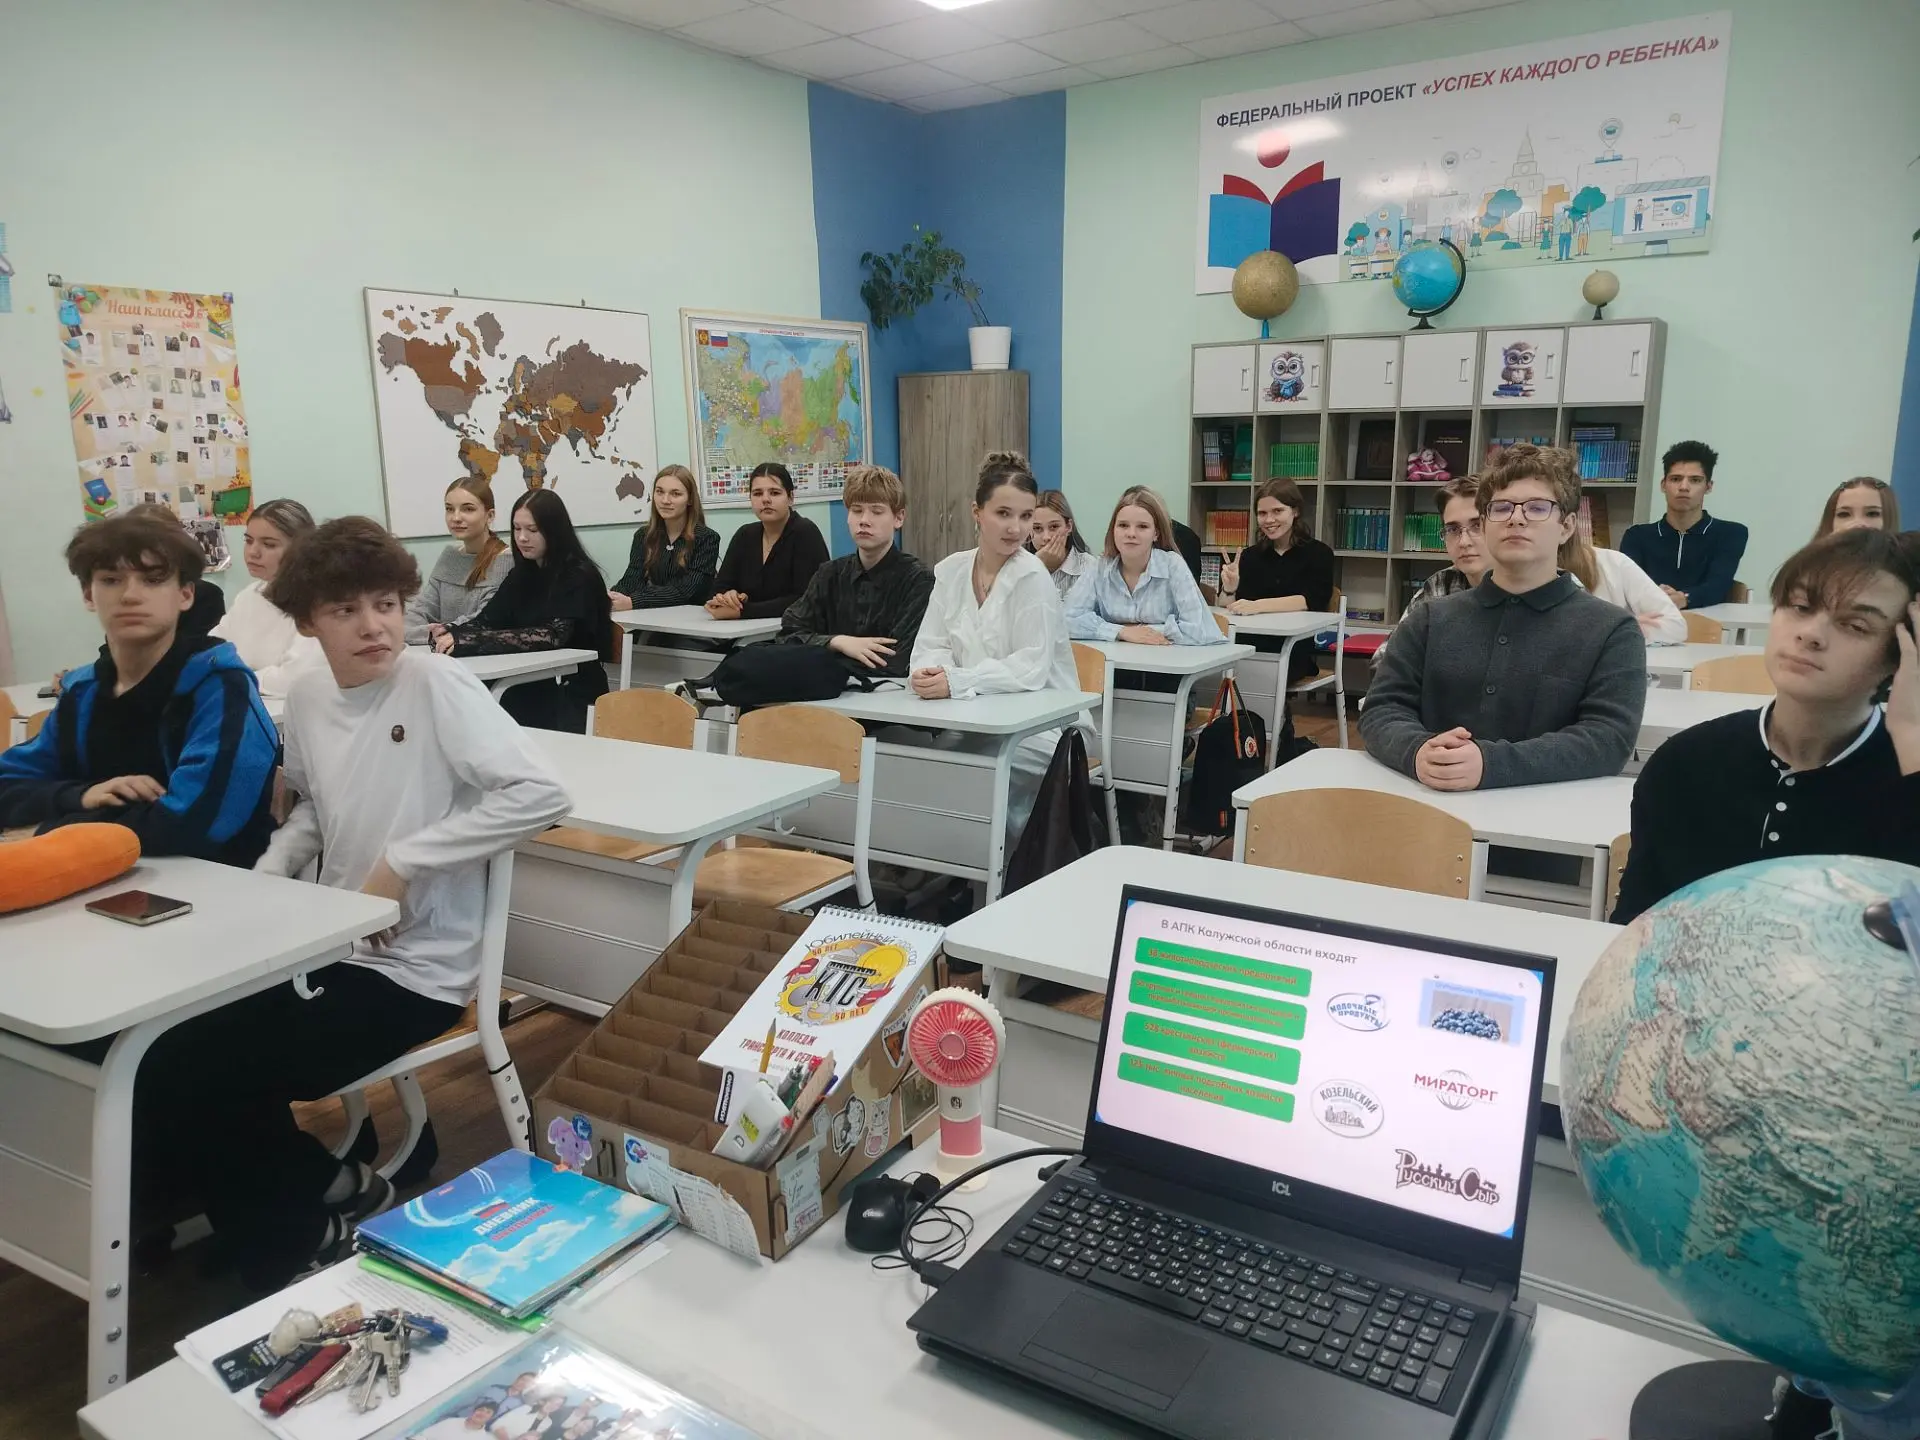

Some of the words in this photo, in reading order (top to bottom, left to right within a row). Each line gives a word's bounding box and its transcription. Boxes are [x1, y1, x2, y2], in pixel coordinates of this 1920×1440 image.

[1216, 92, 1342, 128] ФЕДЕРАЛЬНЫЙ
[1347, 83, 1417, 108] ПРОЕКТ
[1421, 70, 1494, 96] «УСПЕХ
[1499, 53, 1602, 85] КАЖДОГО
[1607, 35, 1720, 67] РЕБЕНКА»
[107, 300, 141, 315] Наш
[144, 304, 184, 319] класс
[805, 929, 896, 951] Юбилейный
[1161, 919, 1168, 928] В
[1171, 921, 1195, 934] АПК
[1198, 926, 1261, 947] Калужской
[1264, 938, 1312, 956] области
[1315, 949, 1358, 965] входят
[1330, 1001, 1377, 1017] МОЛОЧНЫЕ
[1338, 1009, 1383, 1028] ПРОДУКТЫ
[776, 1029, 818, 1046] КОЛЛЕДЖ
[1414, 1073, 1498, 1101] МИРАТОРГ
[1320, 1087, 1378, 1114] КОЗЕЛЬСКИЙ
[1395, 1149, 1458, 1195] Русский
